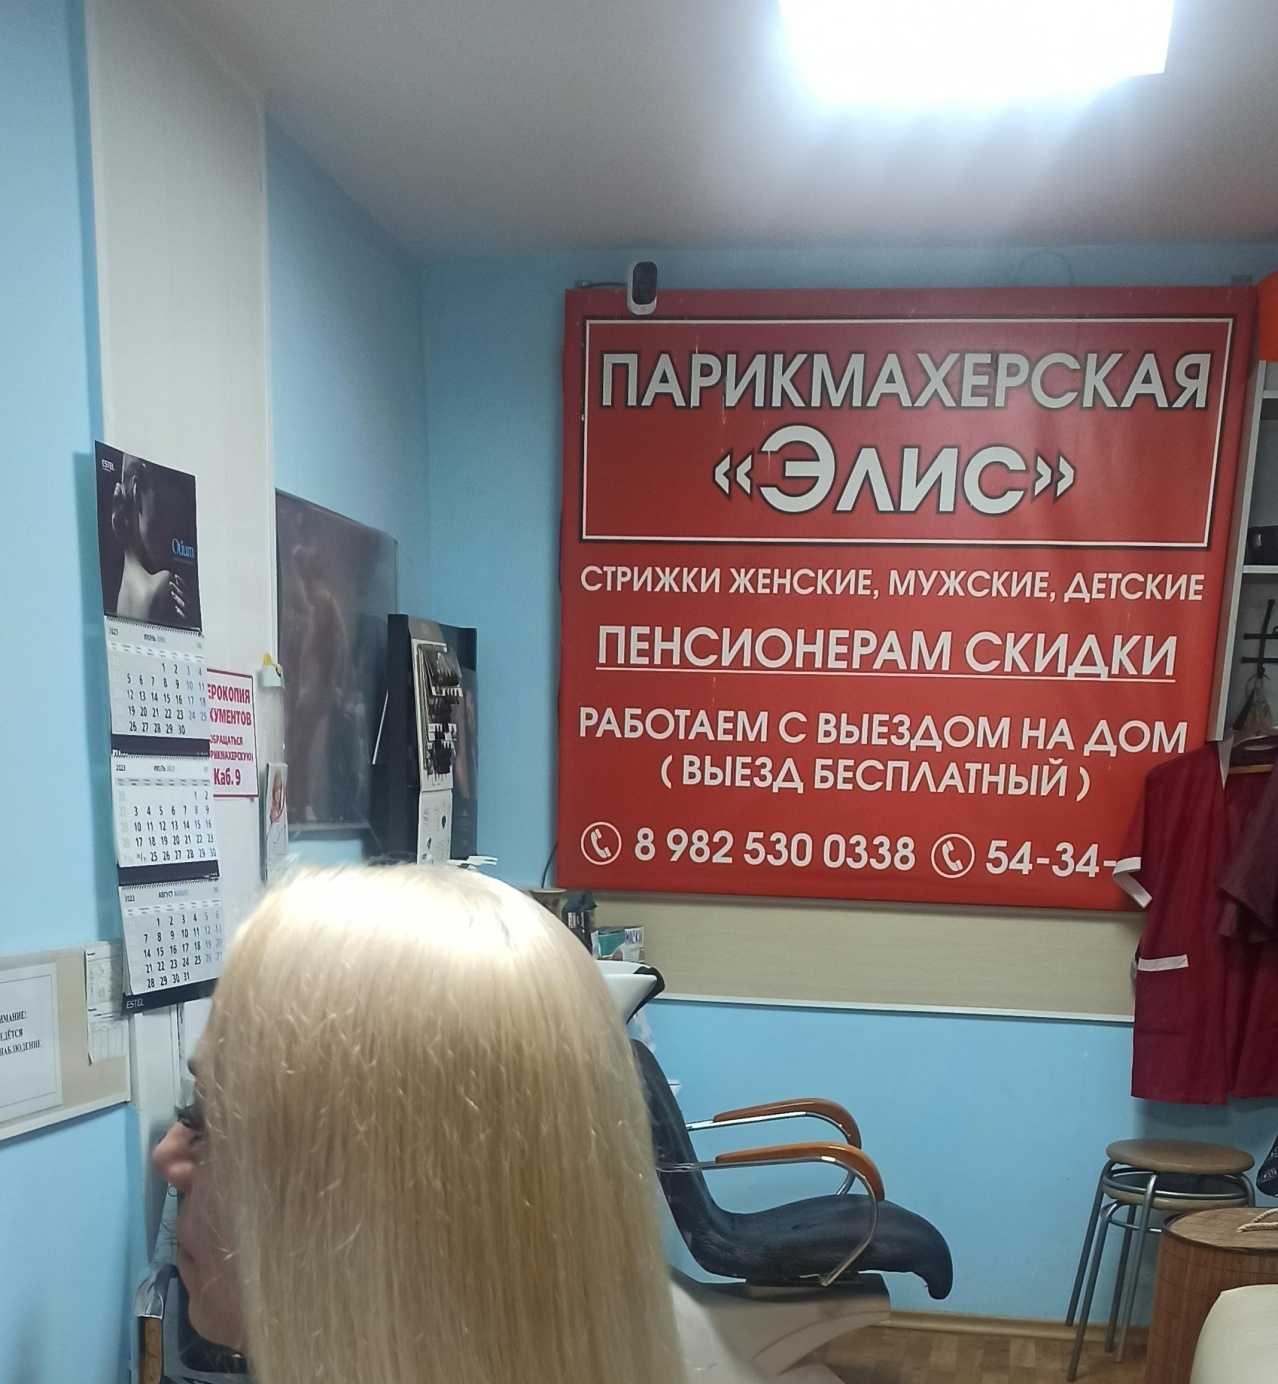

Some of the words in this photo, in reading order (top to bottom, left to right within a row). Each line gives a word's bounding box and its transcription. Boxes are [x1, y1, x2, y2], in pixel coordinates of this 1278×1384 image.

[601, 352, 1212, 410] ПАРИКМАХЕРСКАЯ
[580, 565, 721, 594] СТРИЖКИ
[729, 567, 879, 599] ЖЕНСКИЕ,
[888, 570, 1056, 602] МУЖСКИЕ,
[1064, 572, 1205, 603] ДЕТСКИЕ
[598, 625, 953, 670] ПЕНСИОНЕРАМ
[965, 632, 1178, 680] СКИДКИ
[162, 663, 166, 672] 1
[174, 664, 178, 674] 2
[127, 673, 131, 684] 5
[140, 675, 143, 685] 6
[152, 676, 155, 686] 7
[163, 677, 168, 688] 8
[176, 679, 180, 689] 9
[128, 689, 134, 700] 12
[140, 691, 146, 701] 13
[151, 692, 158, 701] 14
[164, 693, 171, 704] 15
[176, 695, 182, 704] 16
[129, 706, 136, 716] 19
[140, 706, 148, 717] 20
[153, 707, 160, 717] 21
[165, 708, 172, 719] 22
[177, 709, 184, 720] 23
[129, 721, 137, 732] 26
[142, 722, 149, 732] 27
[154, 723, 161, 733] 28
[166, 724, 173, 734] 29
[179, 725, 186, 735] 30
[579, 707, 769, 743] РАБОТАЕМ
[778, 712, 808, 743] С
[817, 713, 1011, 752] ВЫЕЗДОМ
[1021, 718, 1075, 751] НА
[1084, 720, 1188, 757] ДОМ
[213, 768, 234, 786] Каб.
[235, 769, 241, 786] 9
[134, 806, 138, 816] 3
[147, 806, 151, 815] 4
[159, 806, 163, 816] 5
[171, 806, 176, 816] 6
[183, 805, 187, 815] 7
[205, 805, 209, 814] 9
[134, 822, 141, 832] 10
[147, 821, 154, 831] 11
[159, 821, 166, 831] 12
[171, 821, 178, 831] 13
[183, 820, 190, 829] 14
[136, 837, 143, 847] 17
[149, 836, 156, 846] 18
[161, 836, 168, 846] 19
[173, 835, 180, 845] 20
[184, 834, 191, 844] 21
[150, 851, 158, 861] 25
[162, 850, 170, 861] 26
[174, 850, 182, 860] 27
[187, 849, 194, 859] 28
[634, 827, 656, 861] 8
[666, 829, 734, 864] 982
[743, 832, 813, 867] 530
[823, 834, 916, 871] 0338
[157, 917, 160, 926] 1
[170, 916, 174, 925] 2
[182, 914, 186, 924] 3
[193, 913, 197, 922] 4
[144, 934, 148, 943] 7
[157, 932, 161, 942] 8
[170, 930, 174, 940] 9
[182, 929, 189, 938] 10
[193, 927, 199, 937] 11
[144, 949, 151, 958] 14
[157, 947, 164, 957] 15
[170, 945, 177, 955] 16
[182, 943, 189, 952] 17
[194, 941, 201, 951] 18
[146, 964, 152, 974] 21
[158, 961, 165, 972] 22
[170, 960, 177, 969] 23
[182, 957, 189, 967] 24
[194, 955, 201, 965] 25
[147, 978, 155, 988] 28
[160, 976, 167, 986] 29
[172, 974, 180, 984] 30
[183, 972, 190, 981] 31
